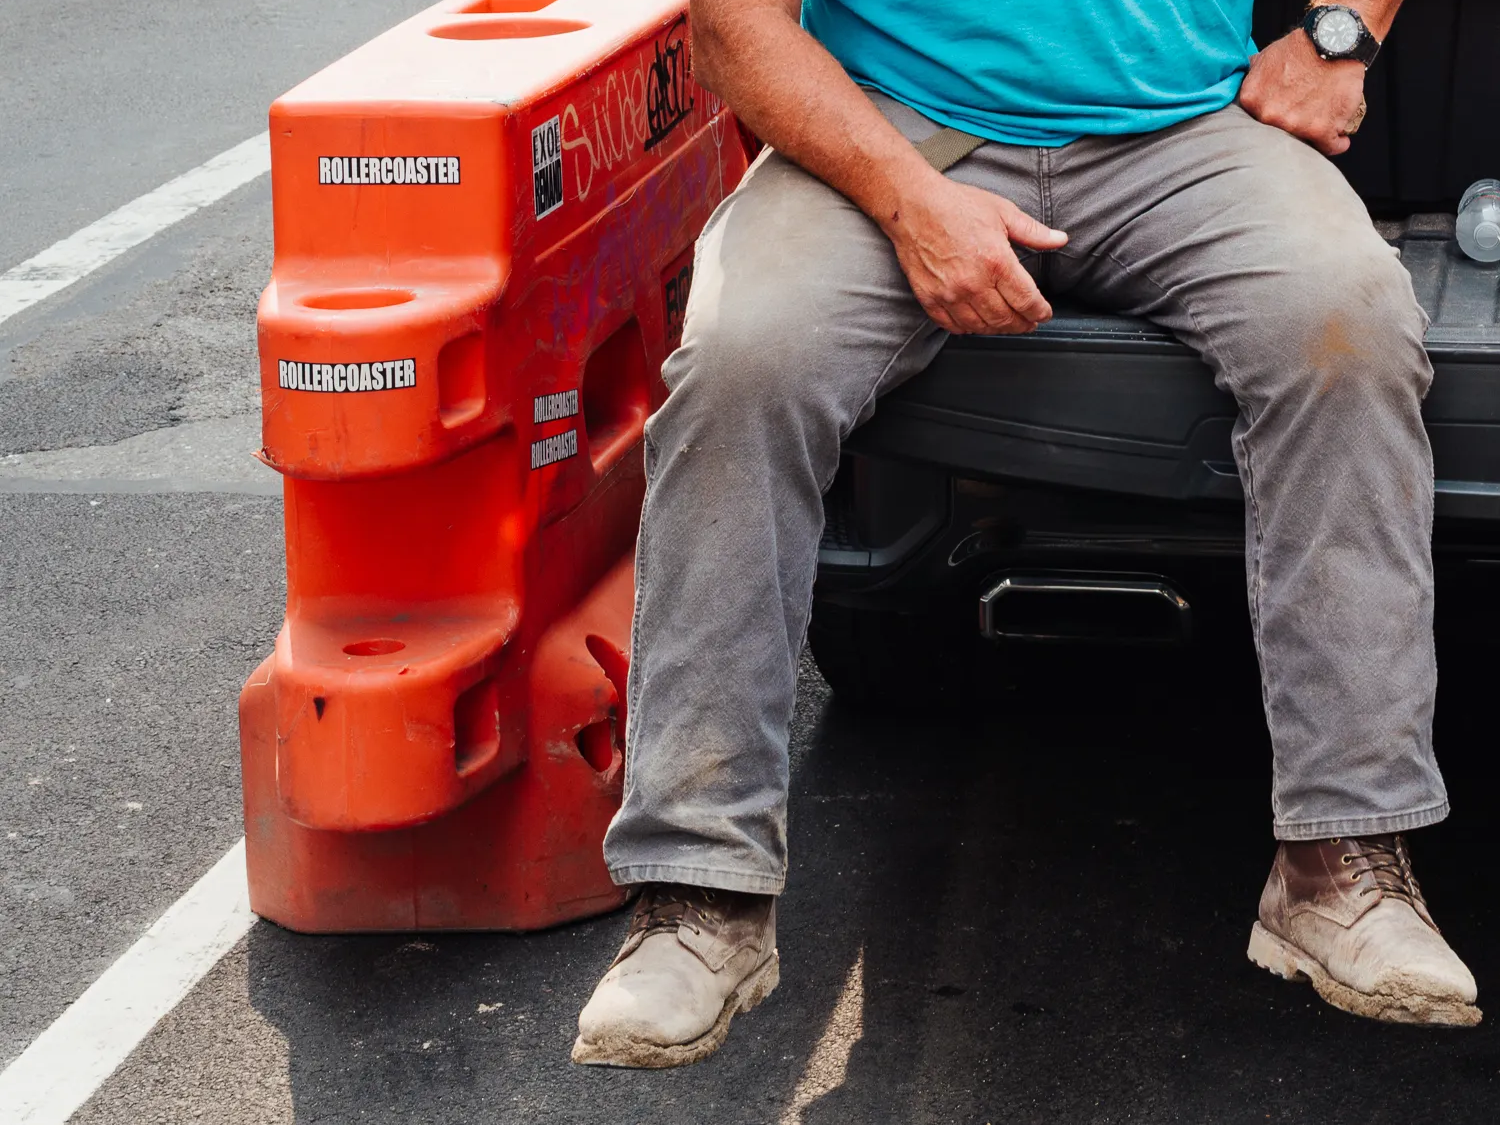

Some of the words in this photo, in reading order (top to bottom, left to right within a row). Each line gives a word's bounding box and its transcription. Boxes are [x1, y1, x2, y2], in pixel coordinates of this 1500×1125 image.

[319, 156, 460, 184] ROLLERCOASTER
[278, 359, 415, 392] ROLLERCOASTER
[534, 389, 579, 424] ROLLERCOASTER
[531, 429, 578, 470] ROLLERCOASTER
